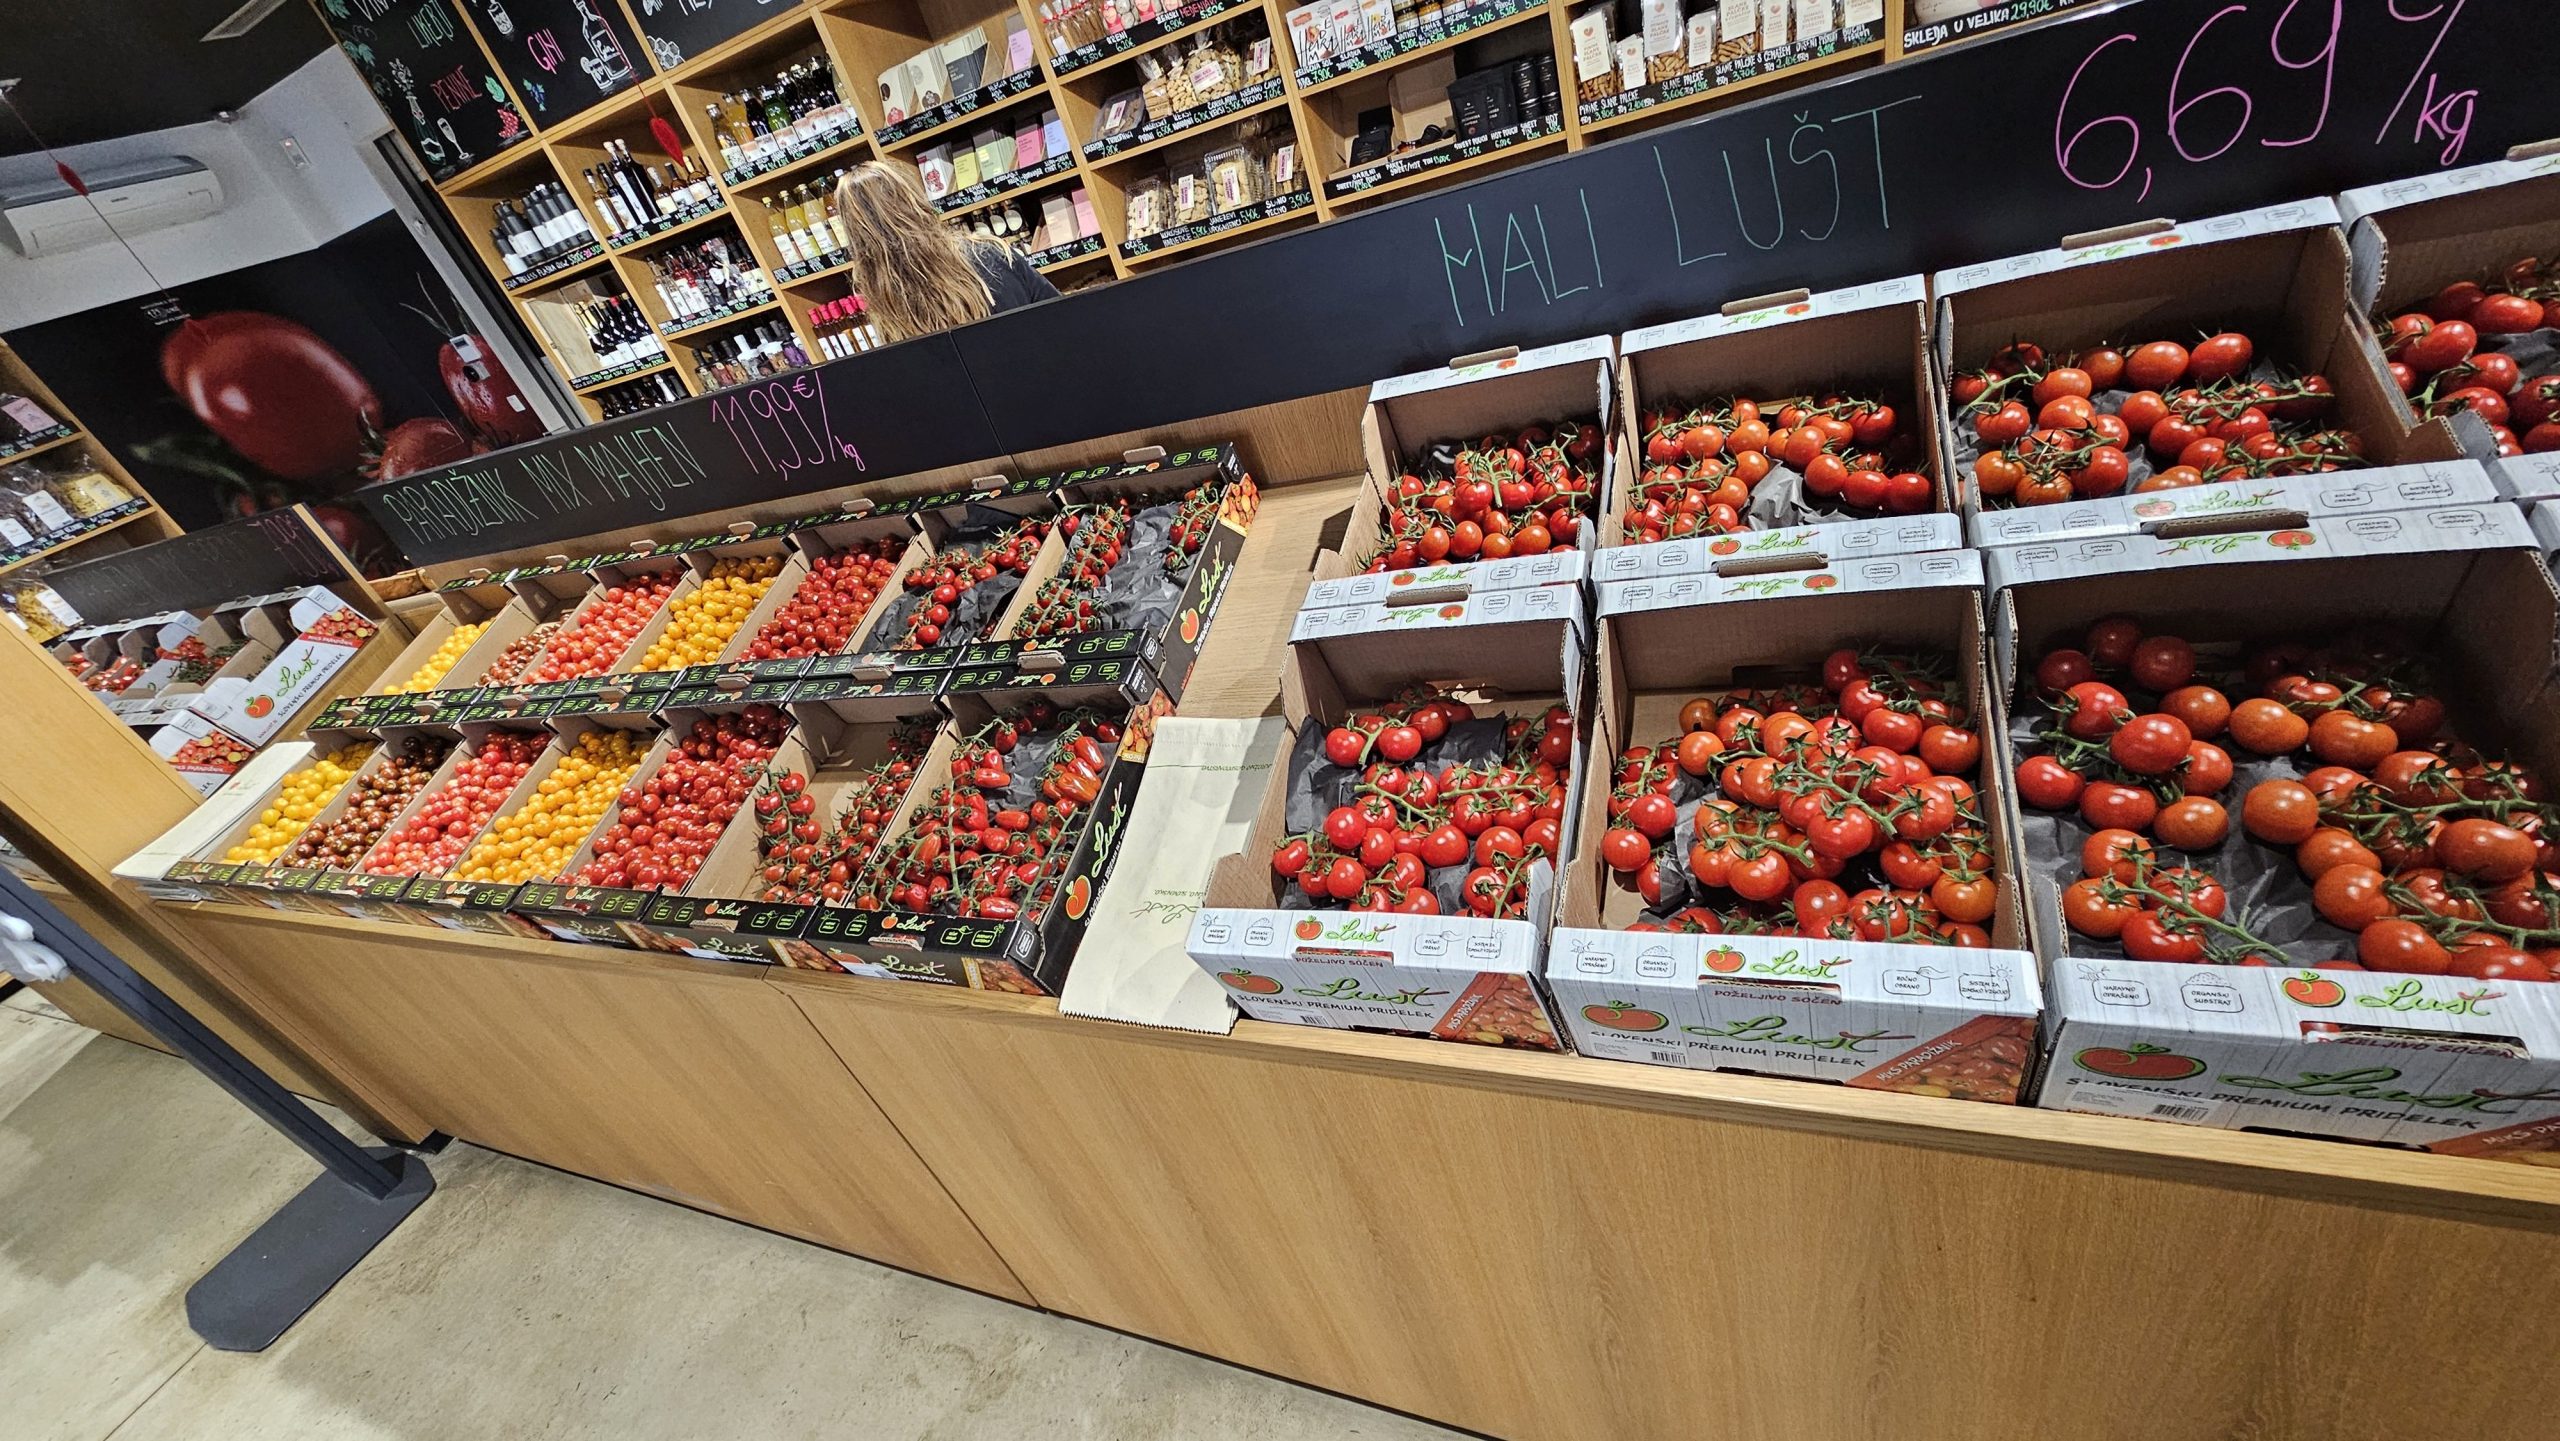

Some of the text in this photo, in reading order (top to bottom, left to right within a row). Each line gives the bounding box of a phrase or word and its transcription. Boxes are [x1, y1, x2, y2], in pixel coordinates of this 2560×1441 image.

[1200, 2, 1225, 20] 5,50€
[1471, 10, 1496, 27] 7,30€
[1966, 8, 2010, 30] VELIKA
[1732, 67, 1758, 83] 3,70€
[1653, 95, 1923, 267] LUŠT
[1288, 191, 1313, 209] 3,90€
[1790, 992, 1843, 1007] SOČEN
[1307, 1000, 1365, 1015] PREMIUM
[1367, 1005, 1436, 1020] PRIDELEK
[1688, 1040, 1768, 1058] PREMIUM
[1774, 1049, 1867, 1068] PRIDELEK
[2210, 1091, 2337, 1115] PREMIUM
[2341, 1107, 2484, 1130] PRIDELEK
